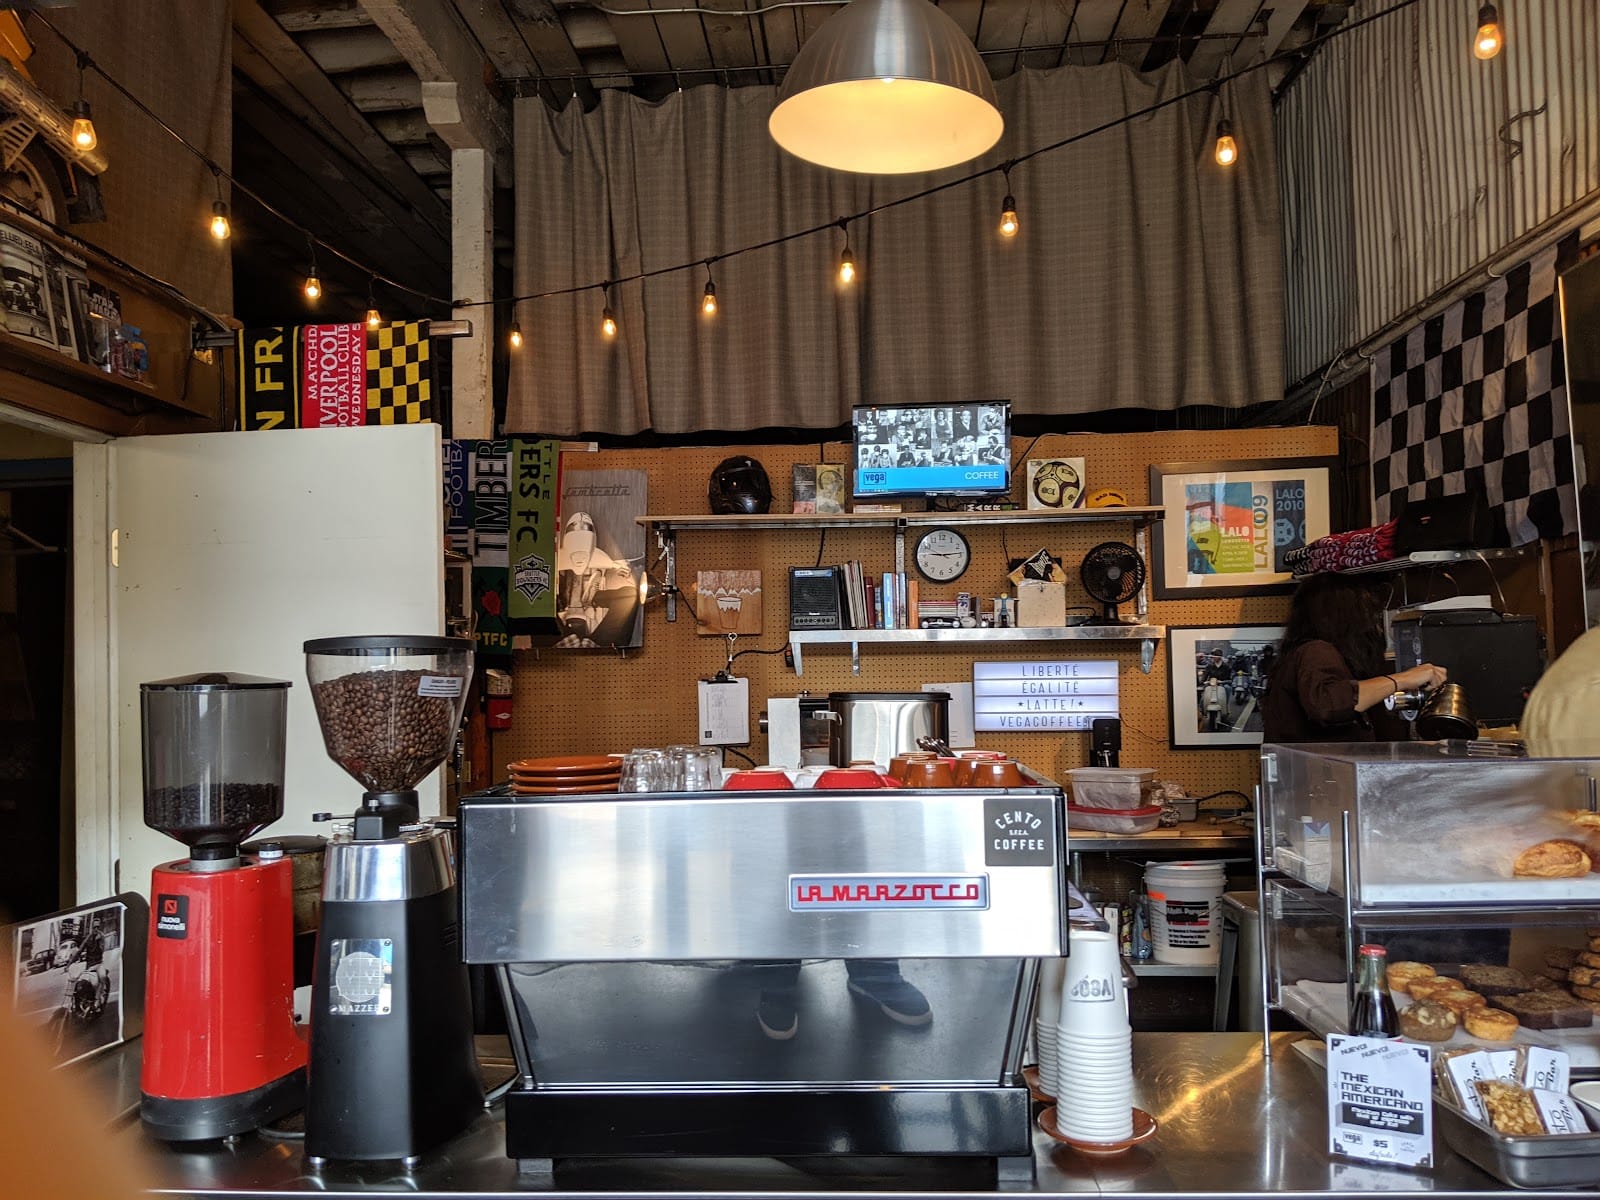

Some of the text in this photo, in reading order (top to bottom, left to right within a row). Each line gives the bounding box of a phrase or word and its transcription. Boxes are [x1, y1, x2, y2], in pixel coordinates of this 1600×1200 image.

[337, 324, 350, 362] CLUB
[254, 326, 284, 393] FR
[351, 335, 361, 427] WEDNESDAY
[865, 471, 999, 483] vega COFFEE
[474, 439, 509, 557] TIMBER
[1275, 488, 1304, 500] LALO
[1276, 500, 1304, 512] 2010
[516, 508, 539, 544] FC
[1220, 526, 1250, 538] LALO
[994, 810, 1042, 830] CENTO
[994, 838, 1045, 850] COFFEE
[1341, 1071, 1369, 1084] THE
[1341, 1082, 1404, 1099] MEXICAN
[1341, 1091, 1424, 1112] AMERICANO
[1373, 1140, 1389, 1149] $5
